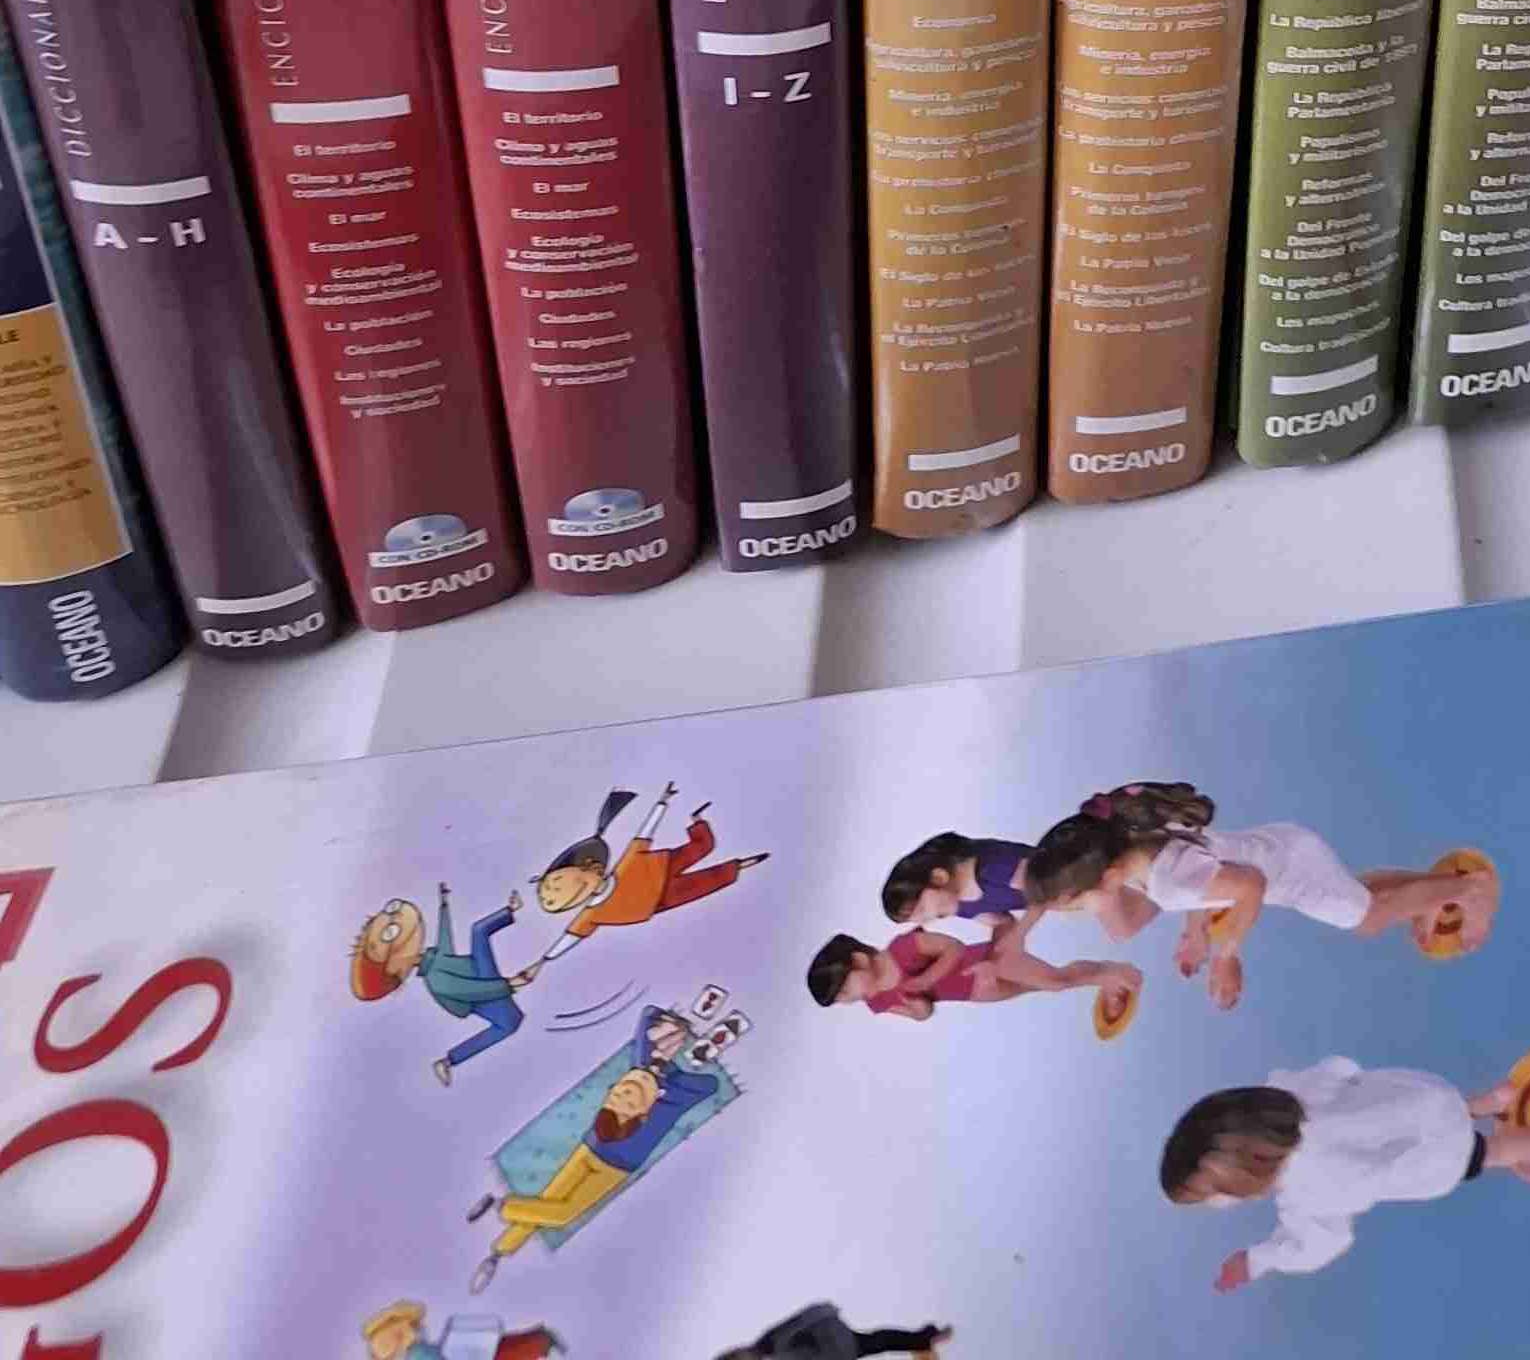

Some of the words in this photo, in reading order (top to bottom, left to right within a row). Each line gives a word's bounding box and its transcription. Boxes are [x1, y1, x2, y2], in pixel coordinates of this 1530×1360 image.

[783, 72, 813, 103] Z
[93, 222, 129, 249] A
[168, 217, 207, 248] H
[1265, 394, 1378, 438] OCEANO
[1068, 442, 1187, 474] OCEANO
[904, 471, 1022, 510] OCEANO
[548, 537, 669, 572] OCEANO
[738, 515, 858, 559] OCEANO
[370, 562, 496, 605] OCEANO
[48, 589, 116, 684] OCEANO
[201, 611, 325, 649] OCEANO
